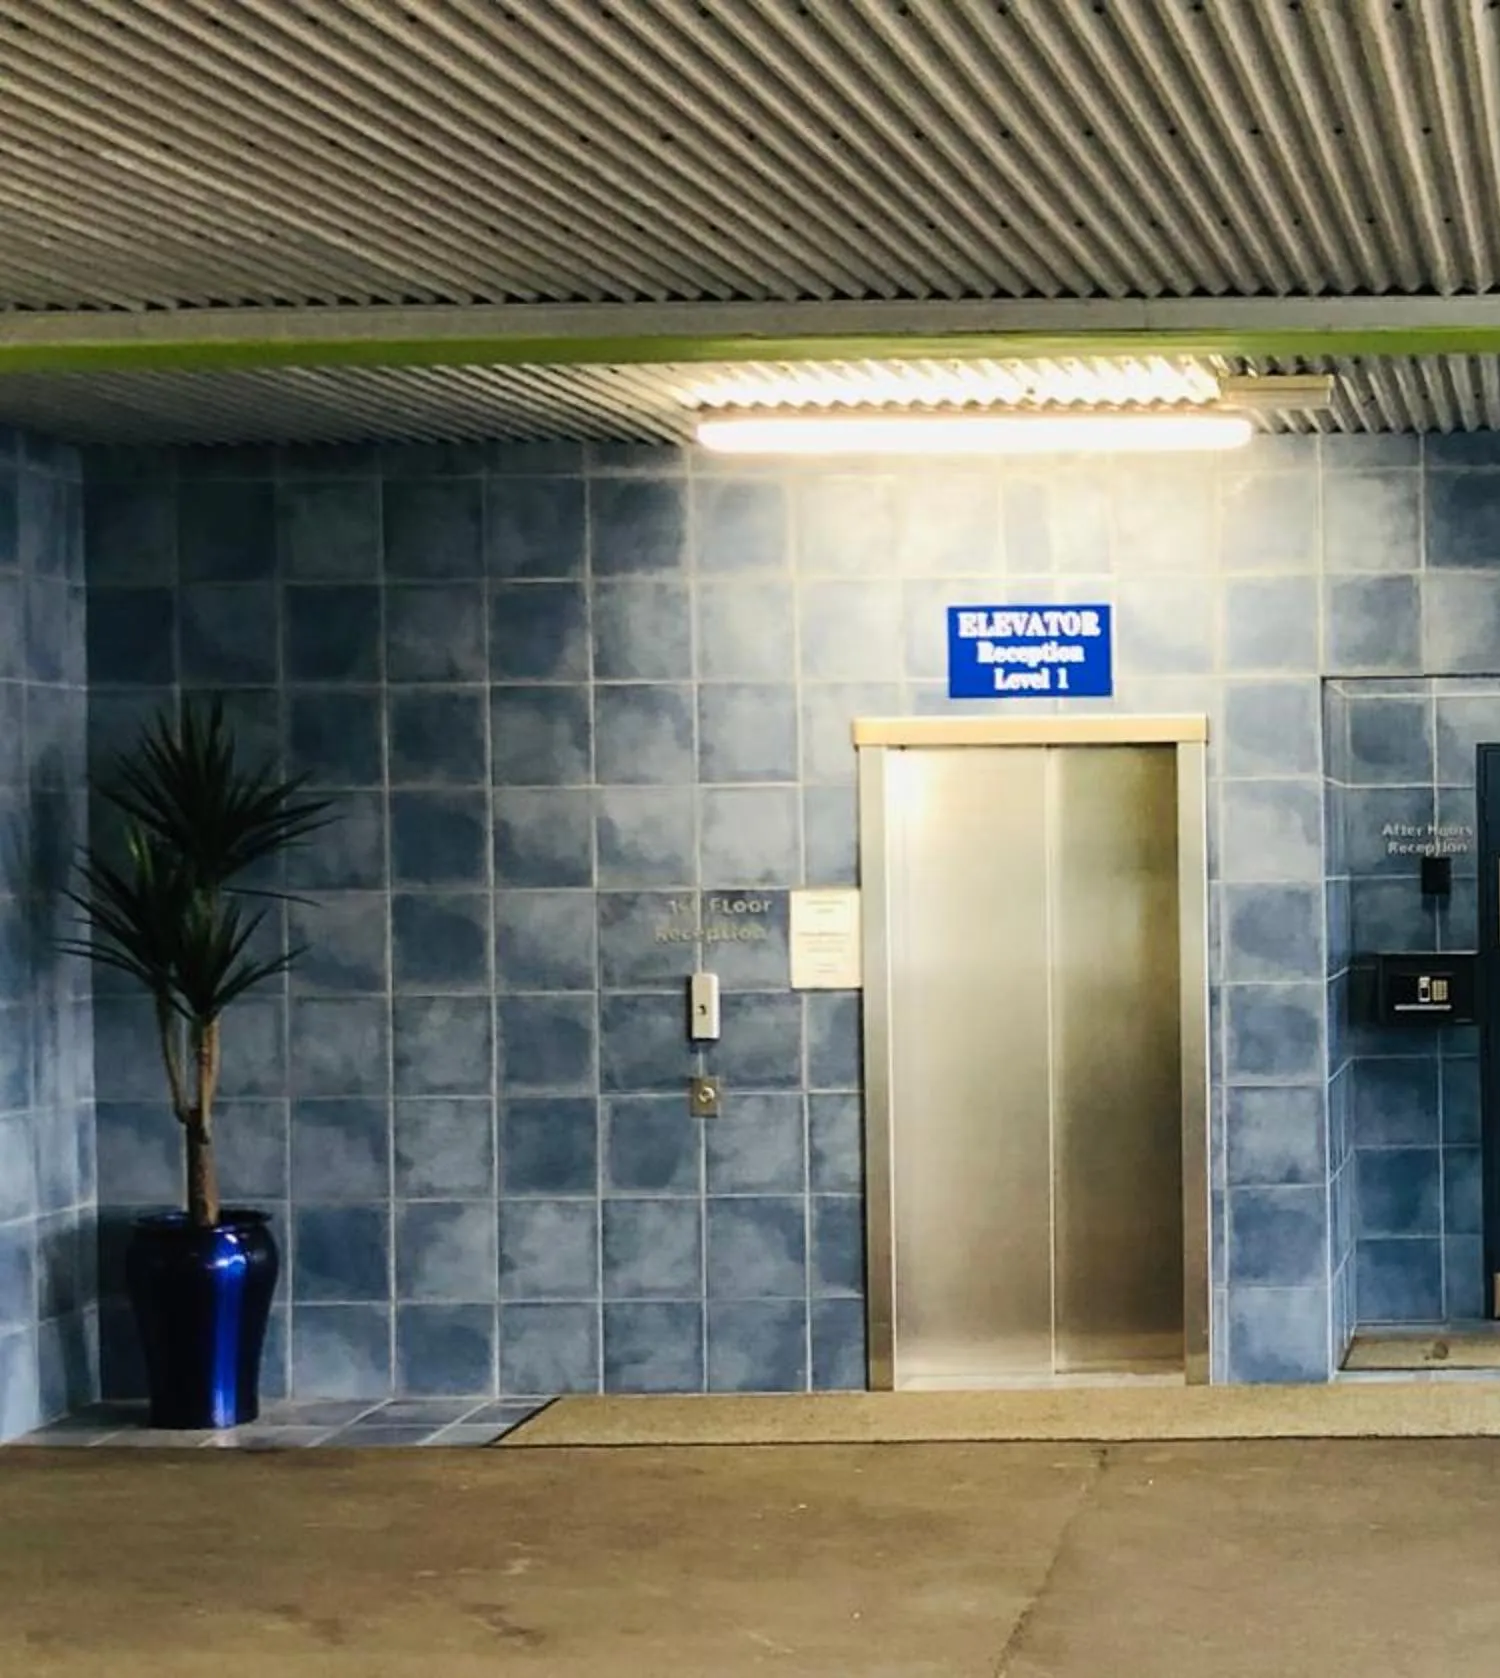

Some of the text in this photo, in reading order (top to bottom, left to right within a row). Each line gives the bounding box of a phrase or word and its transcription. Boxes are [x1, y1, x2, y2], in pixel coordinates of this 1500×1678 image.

[957, 611, 1100, 637] ELEVATOR
[976, 641, 1085, 667] Reception
[994, 668, 1069, 690] Level 1
[1381, 823, 1422, 837] After
[1387, 840, 1468, 857] Reception
